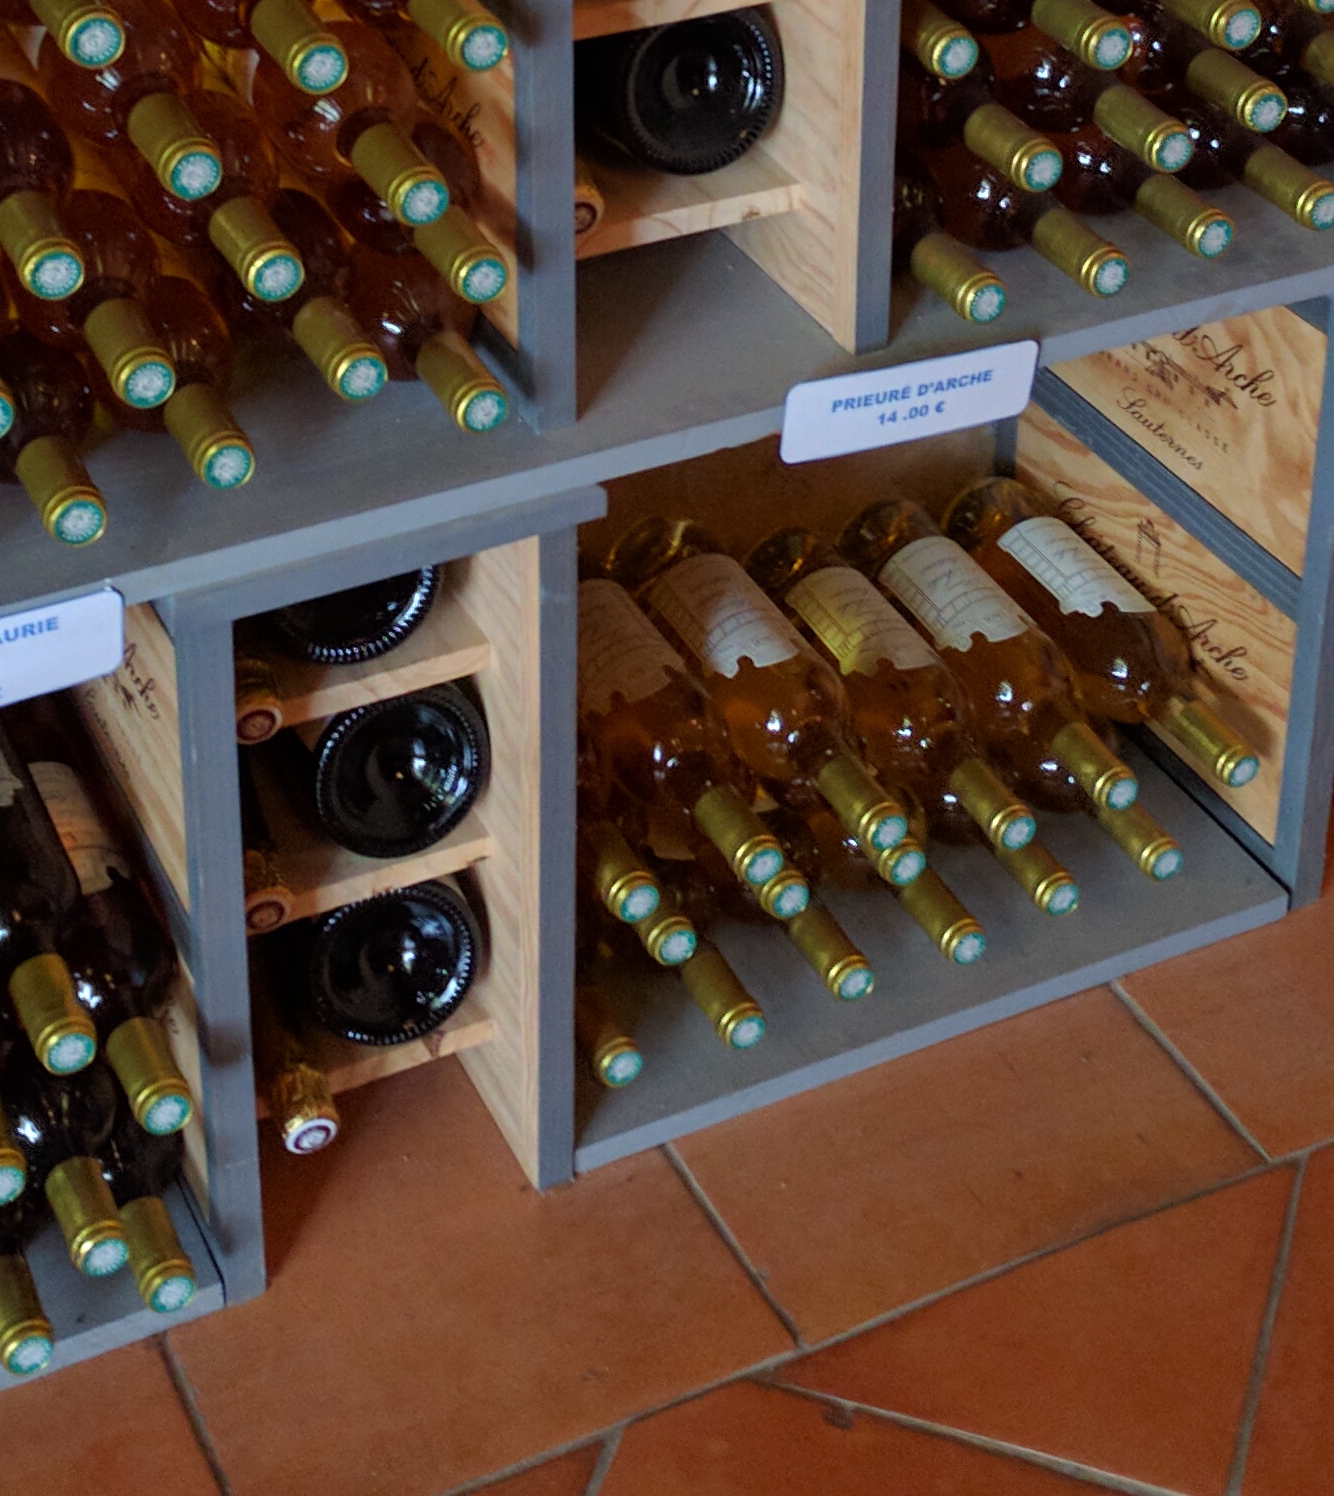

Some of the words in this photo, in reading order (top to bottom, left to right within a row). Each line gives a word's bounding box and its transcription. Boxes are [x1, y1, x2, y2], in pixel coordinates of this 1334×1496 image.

[830, 385, 913, 414] PRIEURÉ
[916, 368, 994, 398] D'ARCHE
[934, 400, 946, 414] €
[1115, 386, 1204, 471] Sauternes
